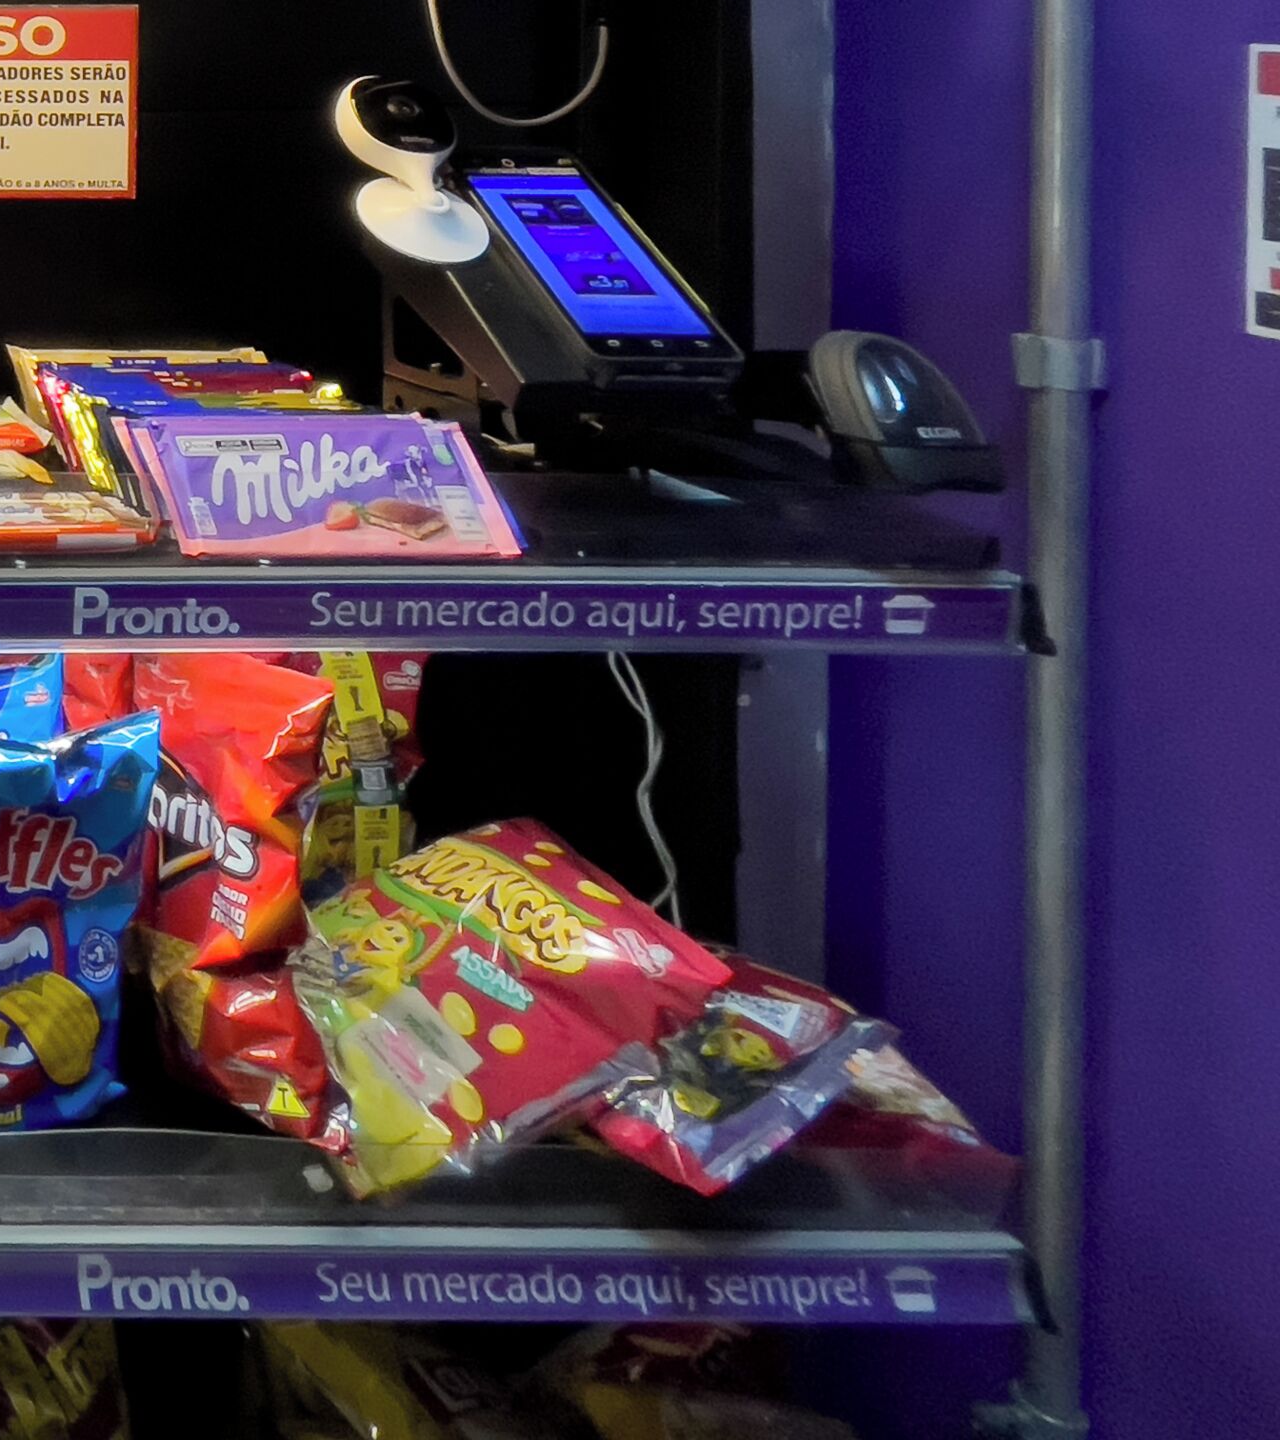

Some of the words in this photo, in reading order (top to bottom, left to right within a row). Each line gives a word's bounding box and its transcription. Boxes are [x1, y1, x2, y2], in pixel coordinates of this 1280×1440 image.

[69, 63, 127, 82] SERÃO
[99, 89, 125, 105] NA
[37, 112, 126, 128] COMPLETA
[43, 179, 76, 189] ANOS
[211, 433, 390, 526] Milka
[73, 587, 240, 636] Pronto.
[78, 1254, 250, 1312] Pronto.
